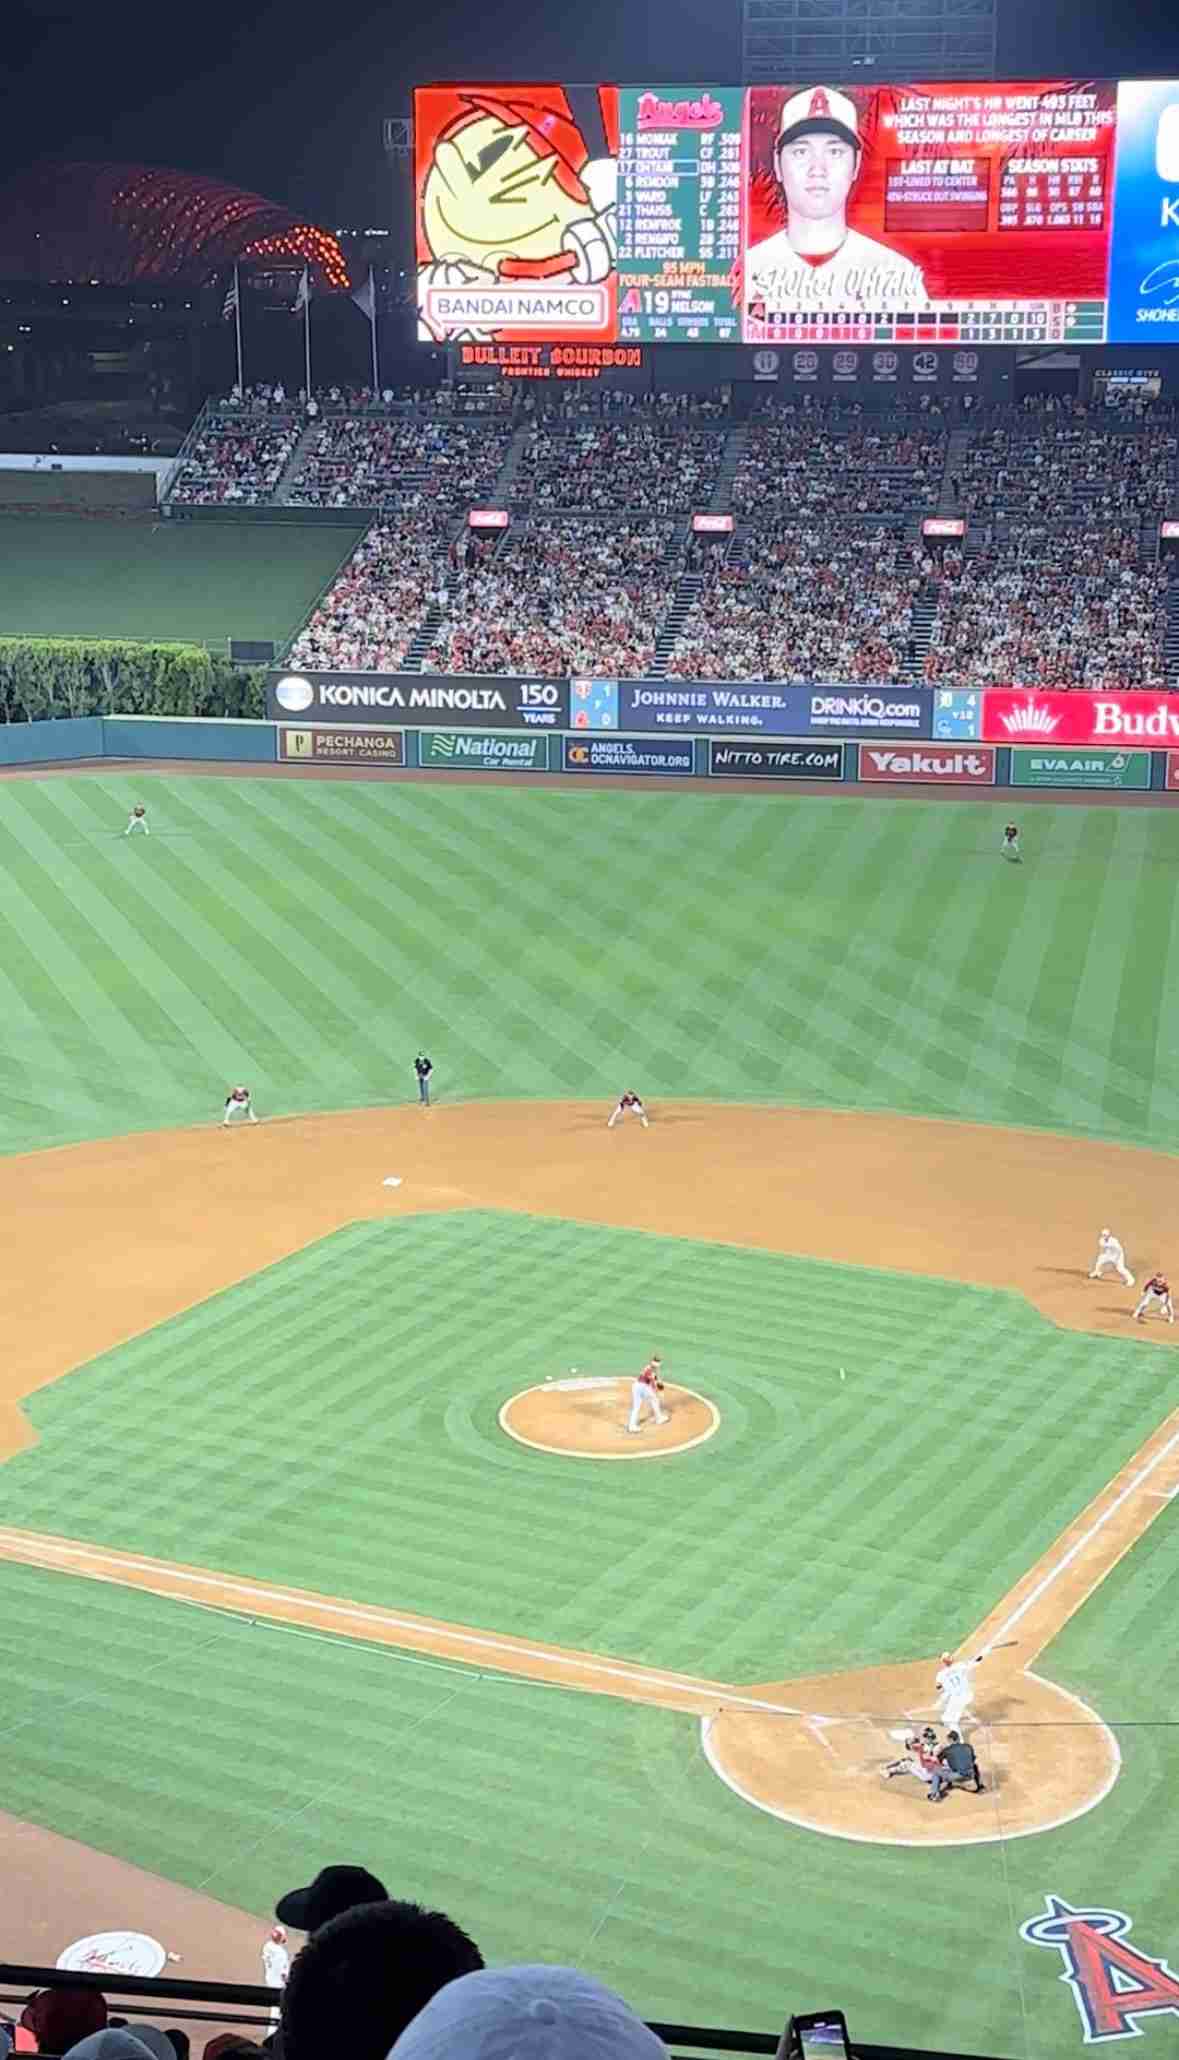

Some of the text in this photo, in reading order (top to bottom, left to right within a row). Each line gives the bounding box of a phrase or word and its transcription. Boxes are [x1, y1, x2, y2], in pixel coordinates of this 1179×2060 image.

[637, 90, 723, 129] Angels
[902, 97, 928, 111] LAST
[1006, 96, 1037, 109] WENT
[1069, 94, 1096, 109] FEET
[884, 113, 924, 128] WHICH
[927, 113, 954, 127] WAS
[1084, 111, 1113, 125] THIS
[897, 130, 944, 143] SEASON
[947, 129, 972, 143] AND
[1032, 128, 1048, 142] OF
[1050, 128, 1096, 141] CAREER
[619, 147, 632, 159] 27
[635, 147, 671, 159] TROUT
[901, 160, 930, 174] LAST
[950, 160, 975, 174] BAT
[1008, 159, 1098, 173] SEASON STATS
[635, 176, 679, 188] RENDON
[635, 191, 666, 203] WARD
[619, 247, 632, 258] 22
[635, 247, 684, 258] FLETCHER
[680, 262, 704, 273] MPH
[619, 274, 685, 287] FOUR-SEAM
[438, 299, 596, 316] BANDAI NAMCO
[644, 291, 669, 313] 19
[672, 301, 715, 313] NELSON
[462, 346, 641, 366] BULLEIT BOURBON
[916, 353, 935, 369] 42
[319, 684, 506, 710] KONICA MINOLTA
[519, 684, 558, 705] 150
[631, 688, 707, 708] JOHNNIE
[522, 713, 556, 724] YEARS
[656, 713, 690, 725] KEEP
[316, 735, 394, 748] PECHANGA
[455, 737, 537, 757] National
[359, 748, 396, 758] CASINO
[715, 749, 839, 769] NITTO TIRE.COM
[483, 757, 500, 765] Car
[591, 754, 690, 768] OCNAVIGATOR.ORG
[868, 752, 986, 775] Yakult
